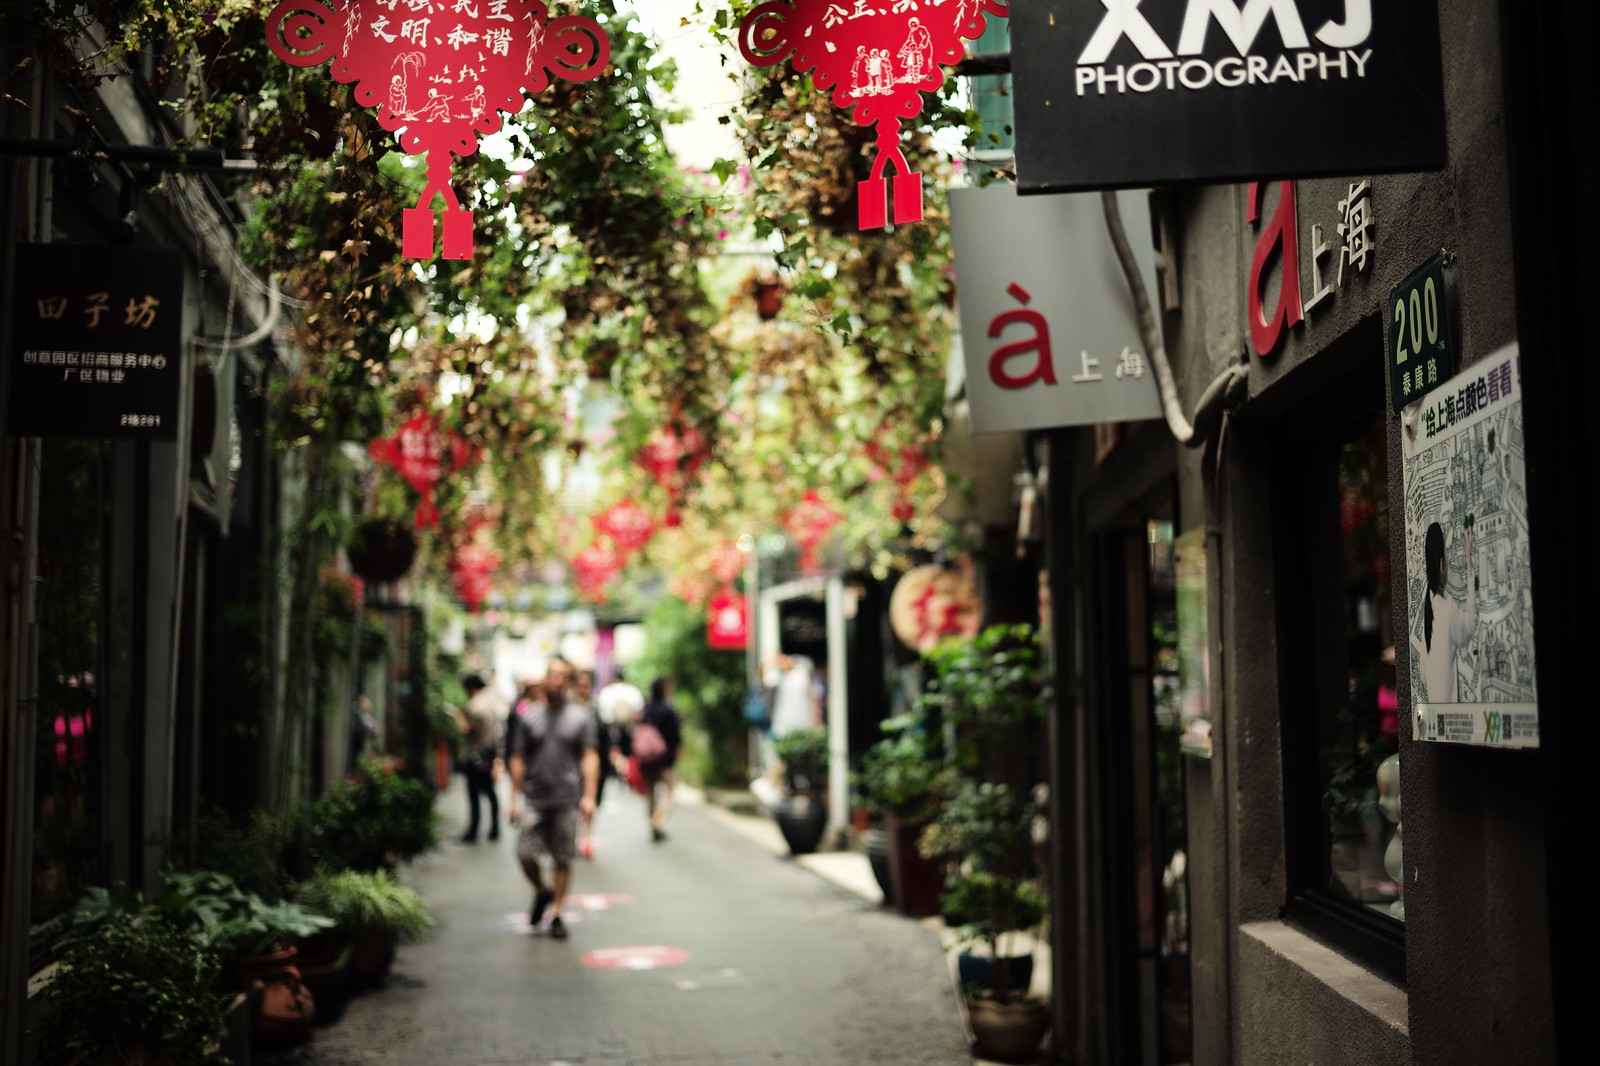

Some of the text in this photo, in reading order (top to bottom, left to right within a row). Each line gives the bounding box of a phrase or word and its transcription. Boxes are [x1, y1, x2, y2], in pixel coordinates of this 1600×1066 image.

[370, 14, 514, 57] 文明、和谐
[1075, 49, 1373, 96] PHOTOGRAPHY
[1304, 179, 1375, 313] 上海
[36, 291, 161, 330] 田子坊
[1394, 276, 1438, 365] 200
[987, 281, 1146, 389] à 上海
[1402, 357, 1438, 396] 泰康路
